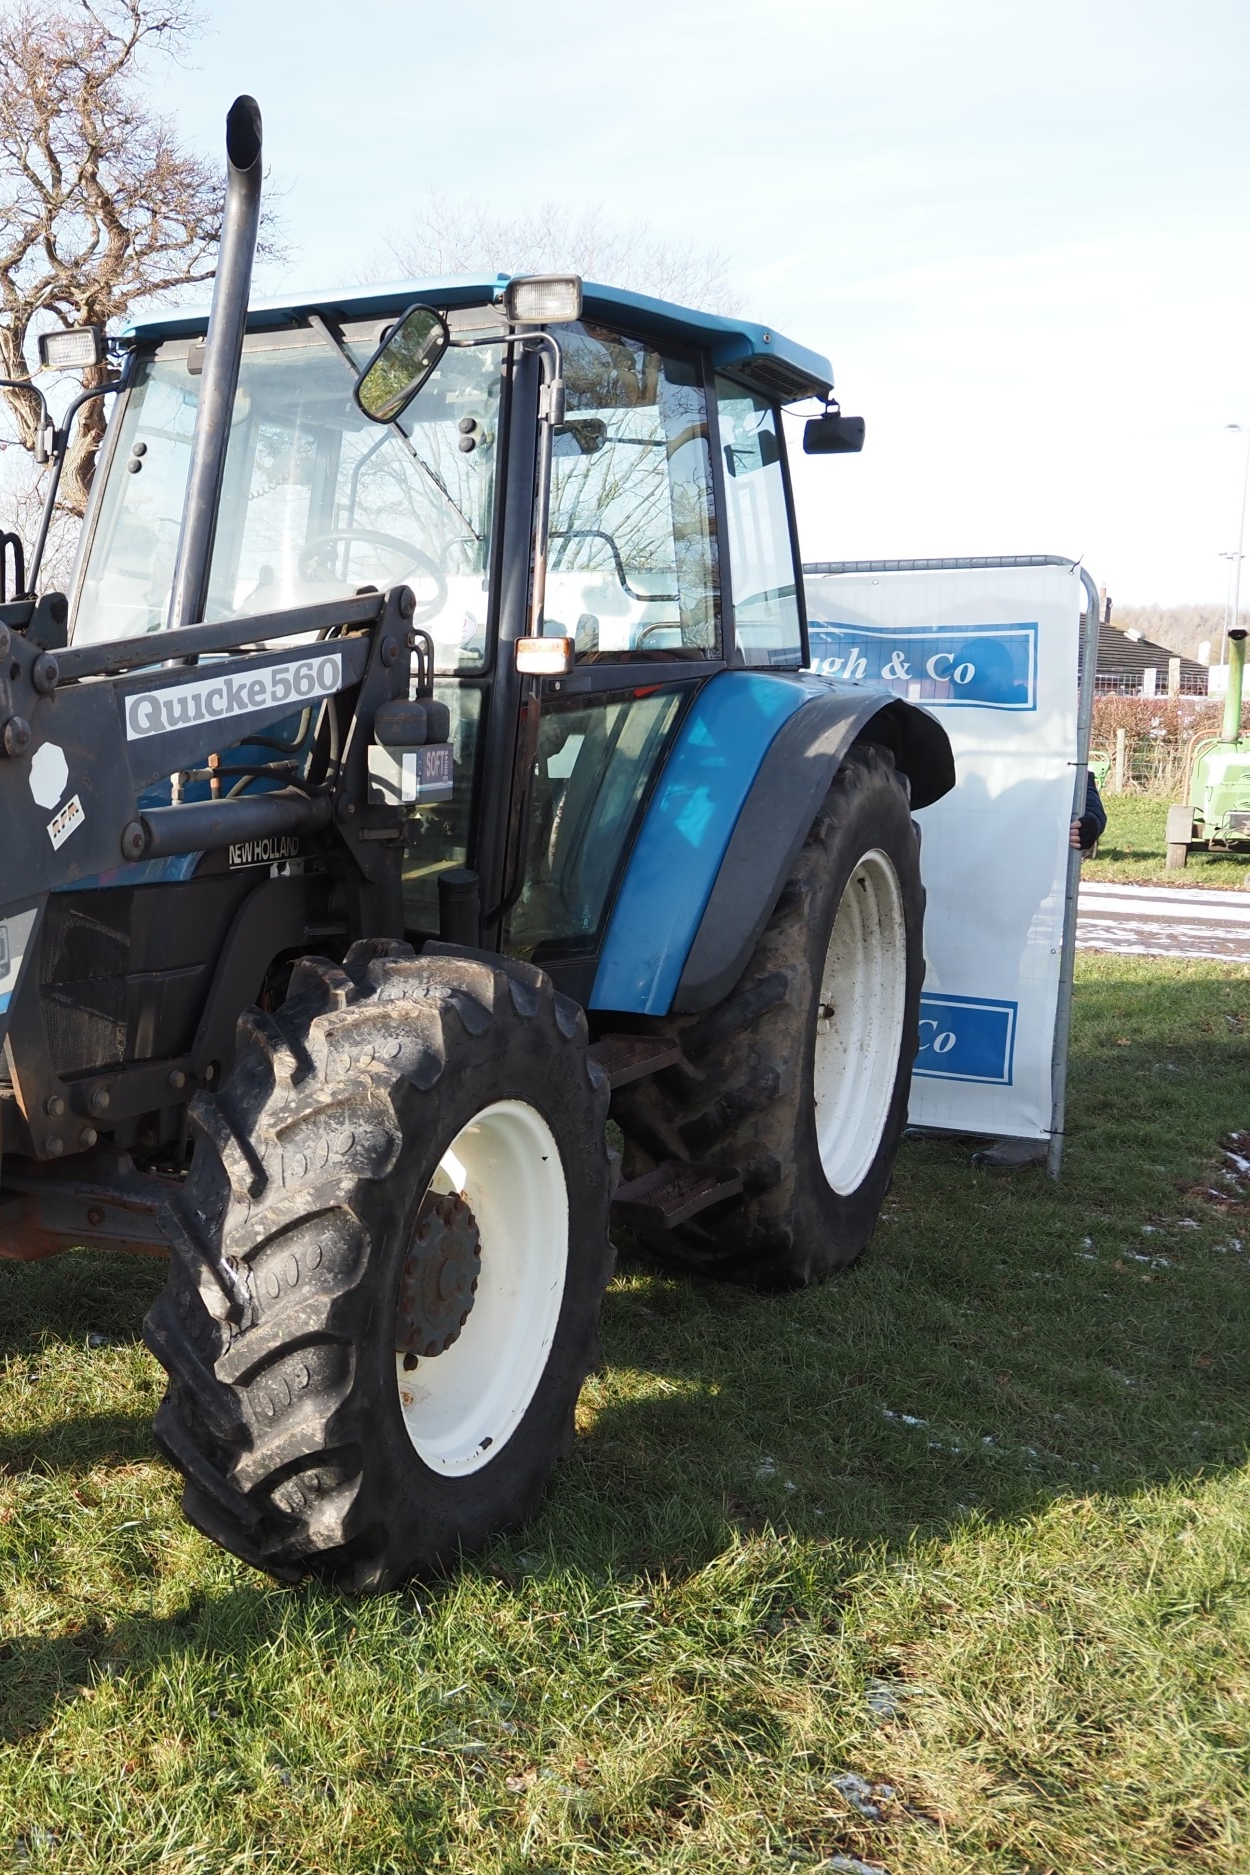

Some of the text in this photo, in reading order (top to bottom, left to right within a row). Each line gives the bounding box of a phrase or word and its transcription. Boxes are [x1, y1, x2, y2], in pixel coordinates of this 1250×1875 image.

[881, 650, 913, 680] &
[925, 652, 976, 685] Co
[426, 749, 445, 777] SOFT
[228, 835, 299, 865] NEW HOLLAND
[918, 1019, 957, 1053] Co
